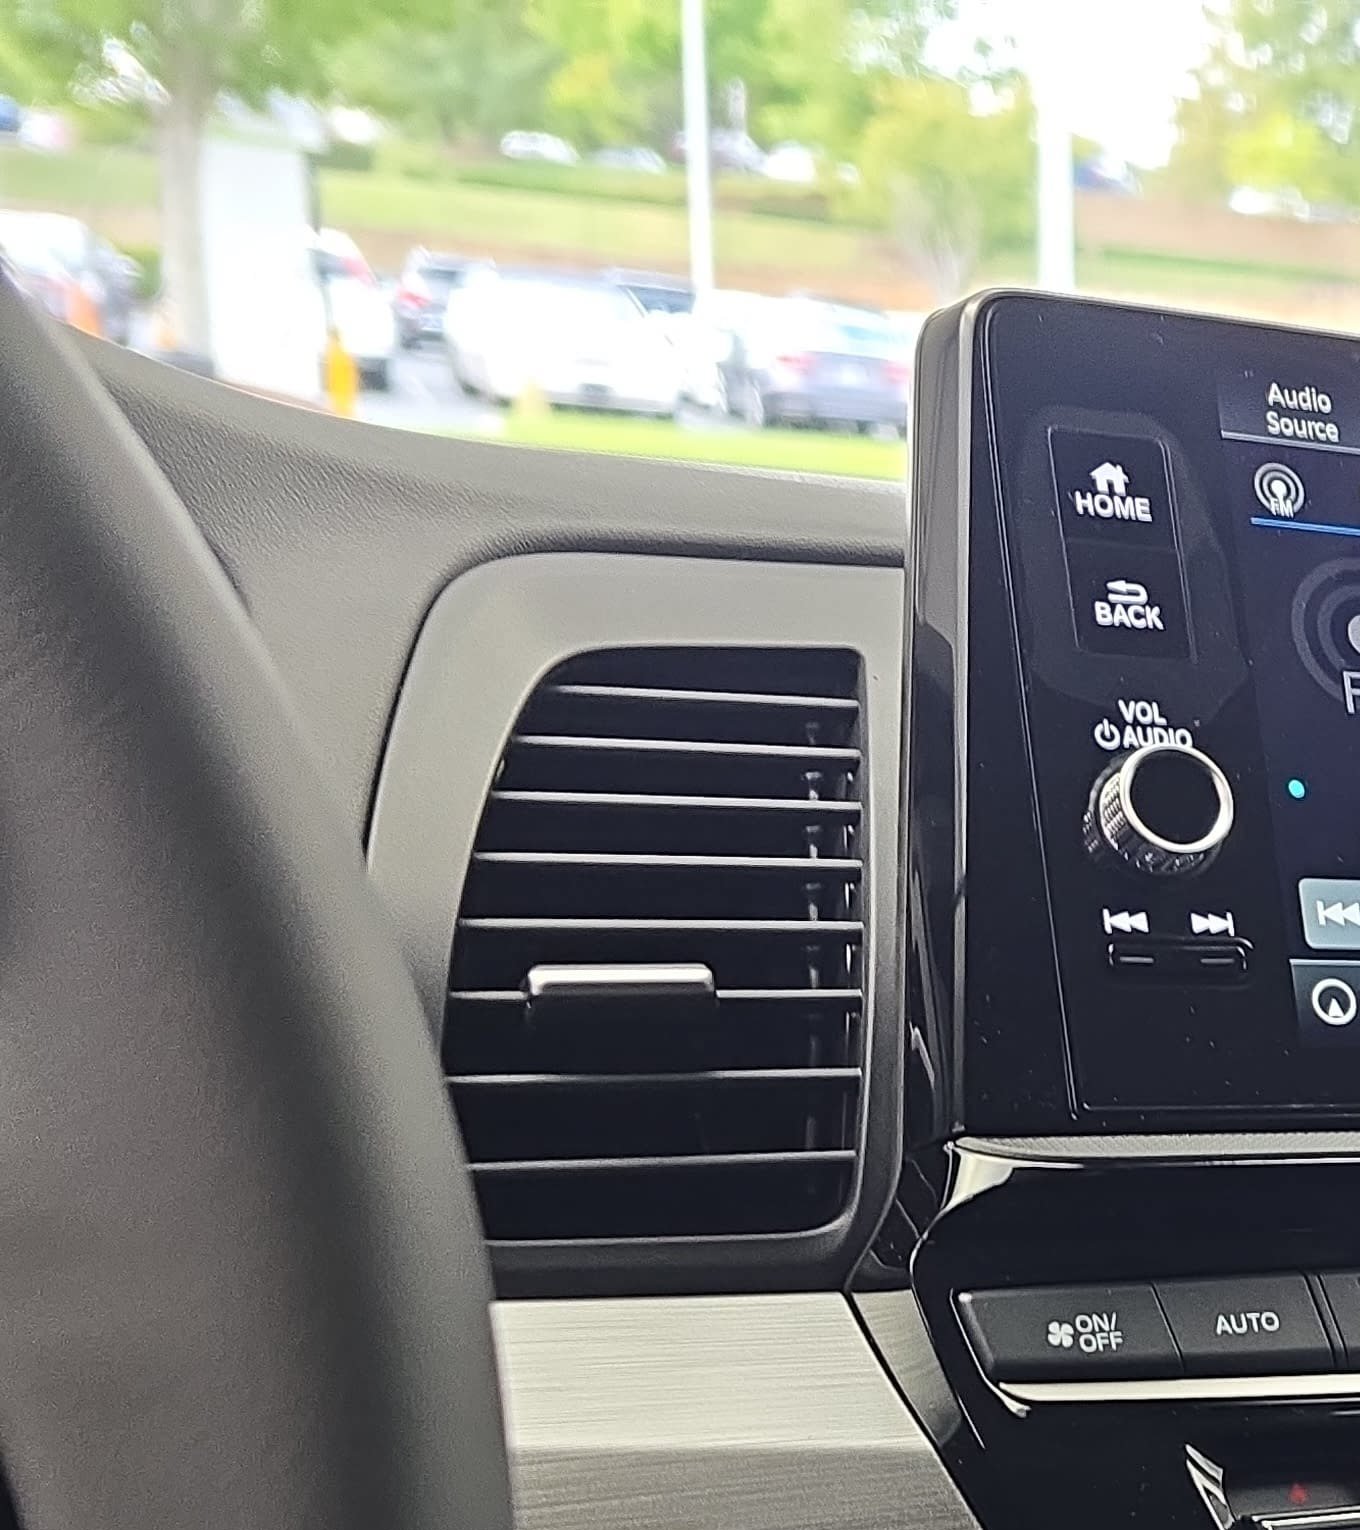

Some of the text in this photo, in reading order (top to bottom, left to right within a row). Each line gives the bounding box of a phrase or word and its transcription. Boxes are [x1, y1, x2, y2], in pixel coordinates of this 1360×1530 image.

[1268, 381, 1332, 414] Audio
[1266, 410, 1340, 443] Source
[1075, 489, 1153, 523] HOME
[1095, 599, 1165, 631] BACK
[1118, 699, 1168, 727] VOL
[1122, 724, 1194, 750] AUDIO
[1075, 1311, 1118, 1333] ON/
[1215, 1311, 1281, 1336] AUTO
[1079, 1328, 1123, 1353] OFF
